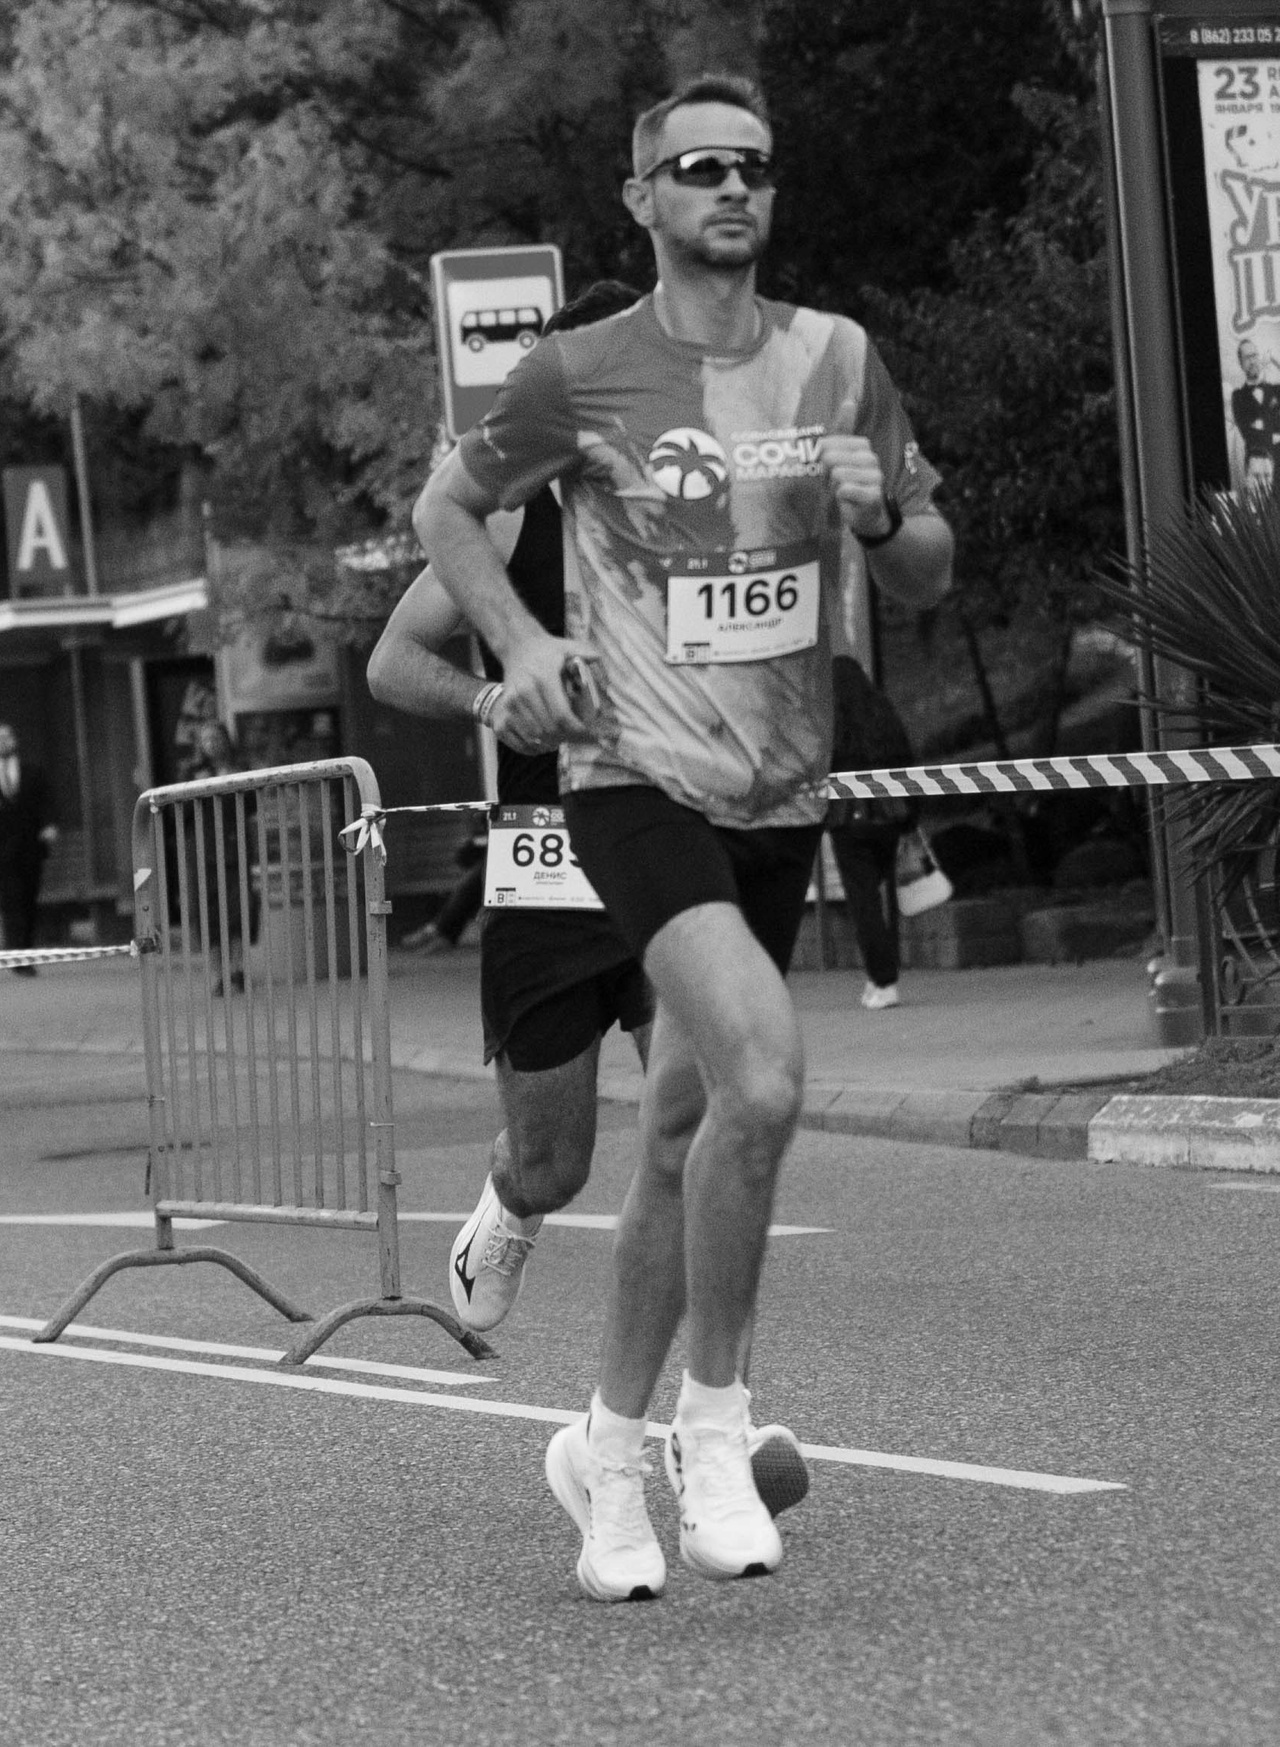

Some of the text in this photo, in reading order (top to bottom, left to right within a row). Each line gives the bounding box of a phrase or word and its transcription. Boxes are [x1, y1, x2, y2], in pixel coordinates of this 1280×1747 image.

[1190, 28, 1199, 44] 8
[1201, 28, 1230, 44] (862)
[1233, 28, 1255, 43] 233
[1257, 28, 1271, 43] 05
[1214, 66, 1260, 100] 23
[698, 573, 798, 620] 1166
[533, 871, 568, 881] ДЕНИС
